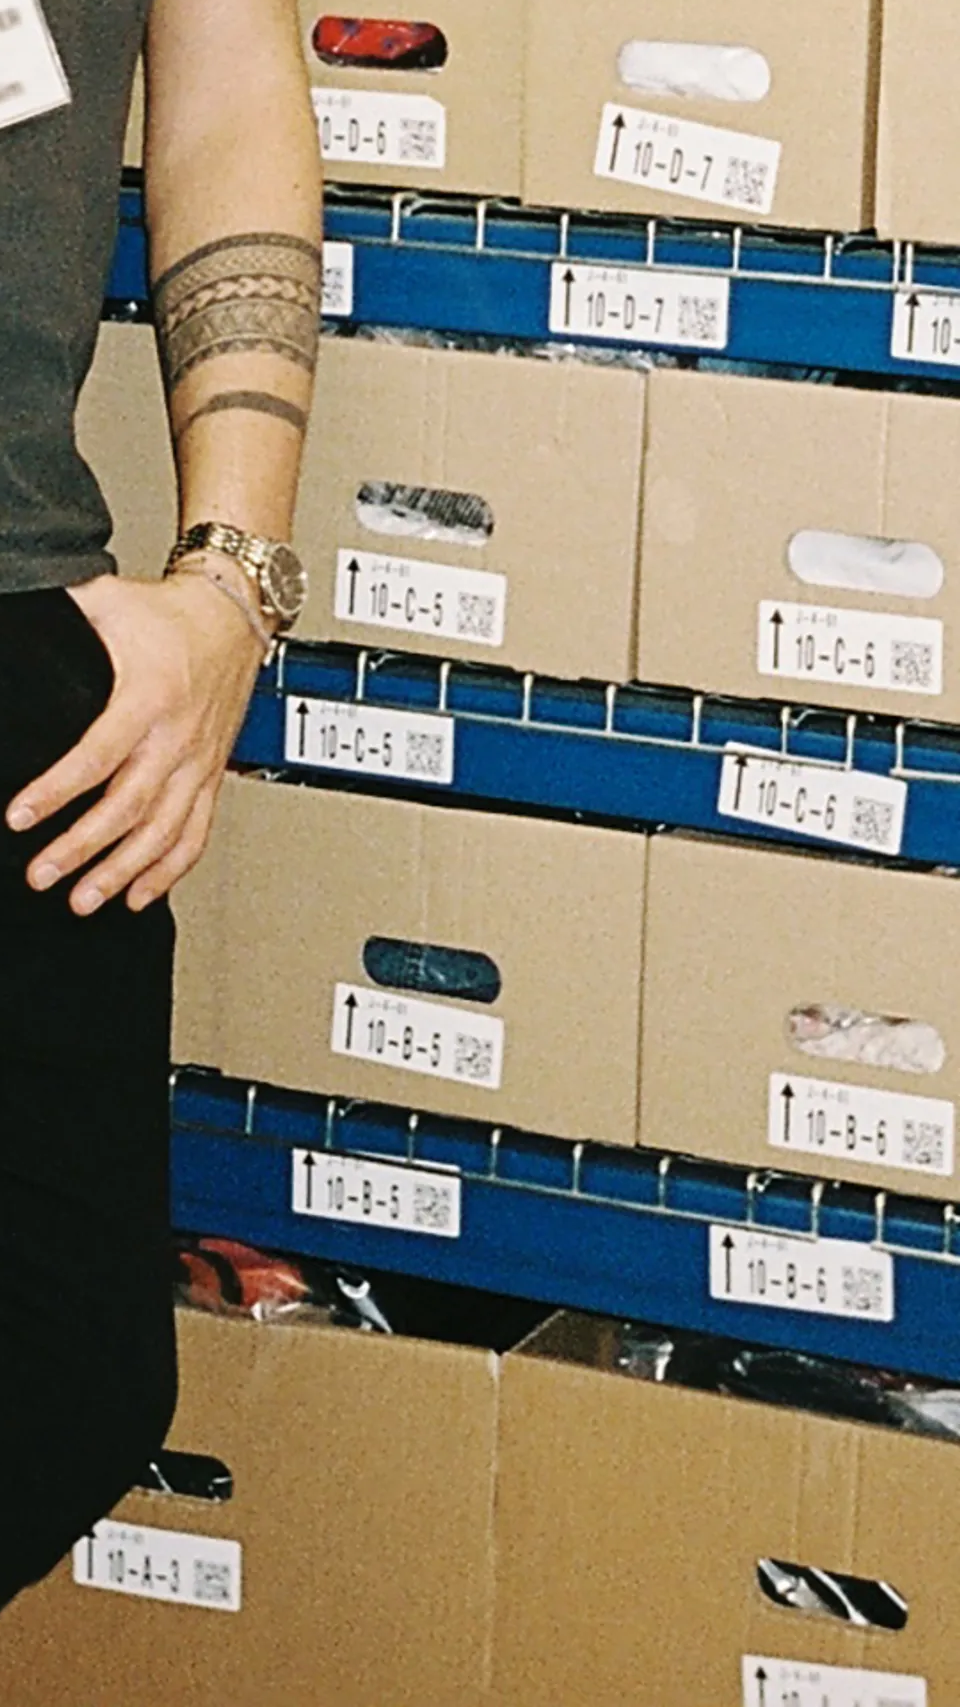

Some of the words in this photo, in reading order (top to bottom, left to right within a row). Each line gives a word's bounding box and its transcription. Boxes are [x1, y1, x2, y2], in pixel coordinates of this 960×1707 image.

[322, 115, 386, 156] 0-D-6
[633, 141, 713, 192] 10-D-7
[587, 291, 664, 334] 10-D-7
[370, 581, 443, 628] 10-C-5
[795, 633, 876, 680] 10-C-6
[320, 723, 393, 769] 10-C-5
[758, 779, 837, 832] 10-C-6
[366, 1019, 440, 1069] 10-B-5
[806, 1109, 886, 1158] 10-B-6
[327, 1176, 400, 1221] 10-B-5
[747, 1258, 826, 1305] 10-B-6
[107, 1547, 178, 1594] 10-A-3
